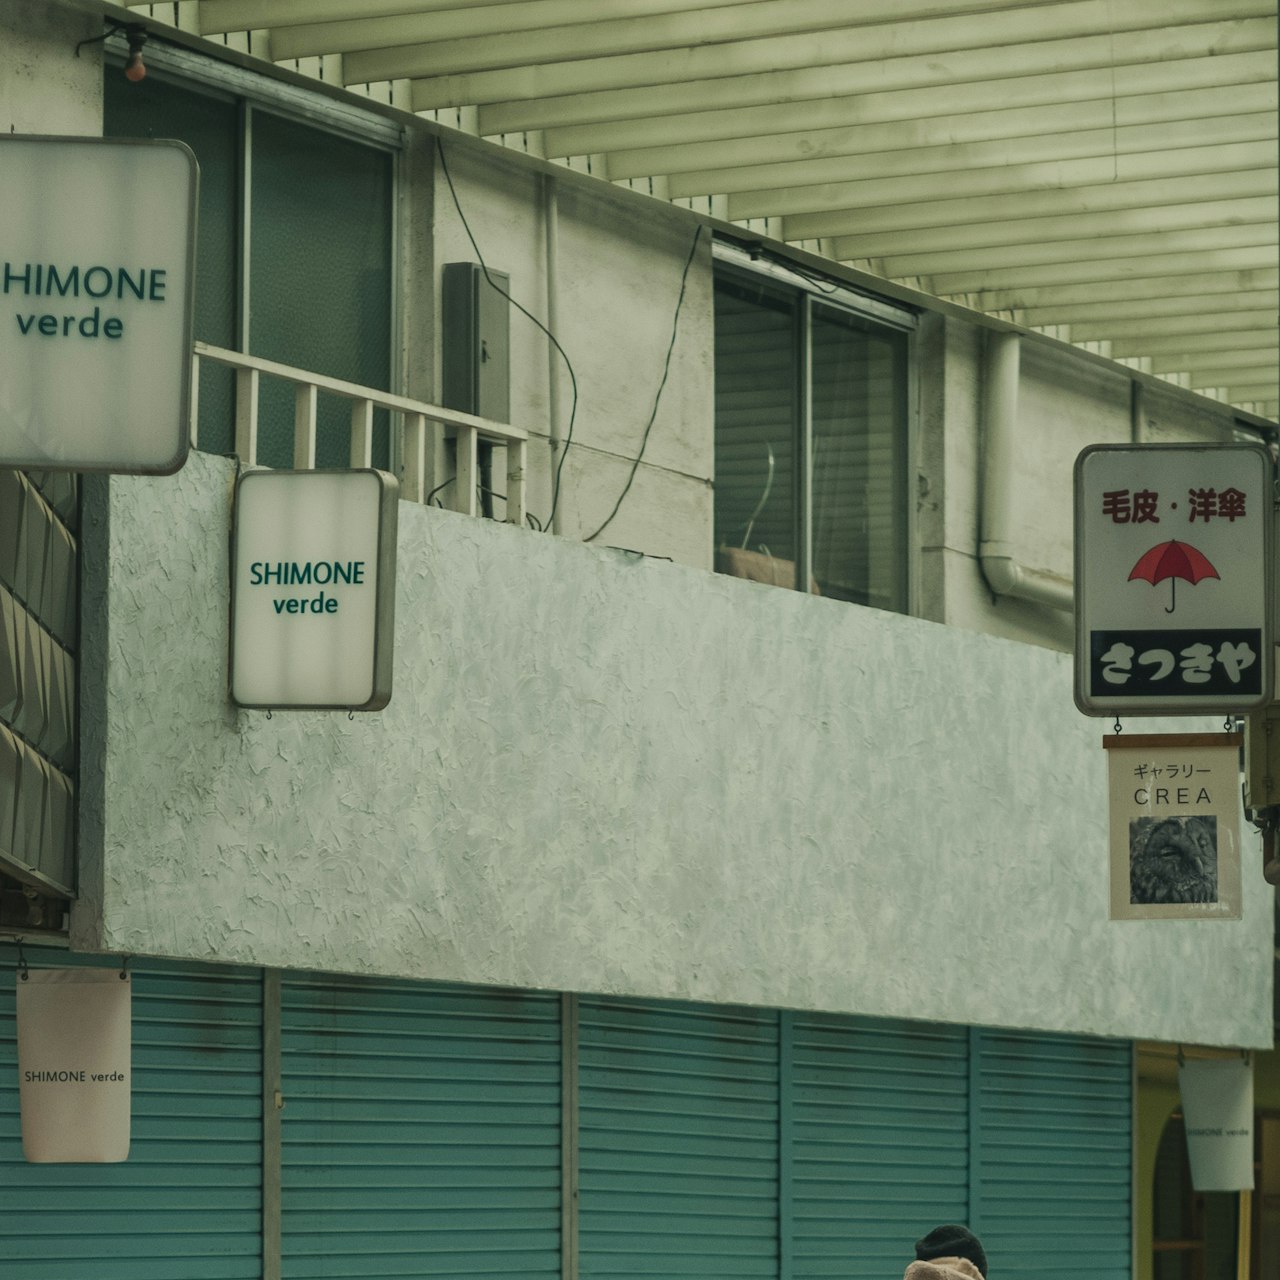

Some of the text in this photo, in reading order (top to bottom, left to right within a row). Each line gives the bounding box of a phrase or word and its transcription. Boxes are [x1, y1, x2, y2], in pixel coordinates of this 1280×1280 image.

[16, 306, 124, 340] verde
[1101, 487, 1248, 525] 毛皮・洋傘
[250, 561, 365, 586] SHIMONE
[273, 590, 339, 615] verde
[1099, 642, 1256, 684] さつきや
[1133, 763, 1211, 780] ギャラリー
[1133, 787, 1212, 805] CREA
[24, 1070, 125, 1083] SHIMONE verde
